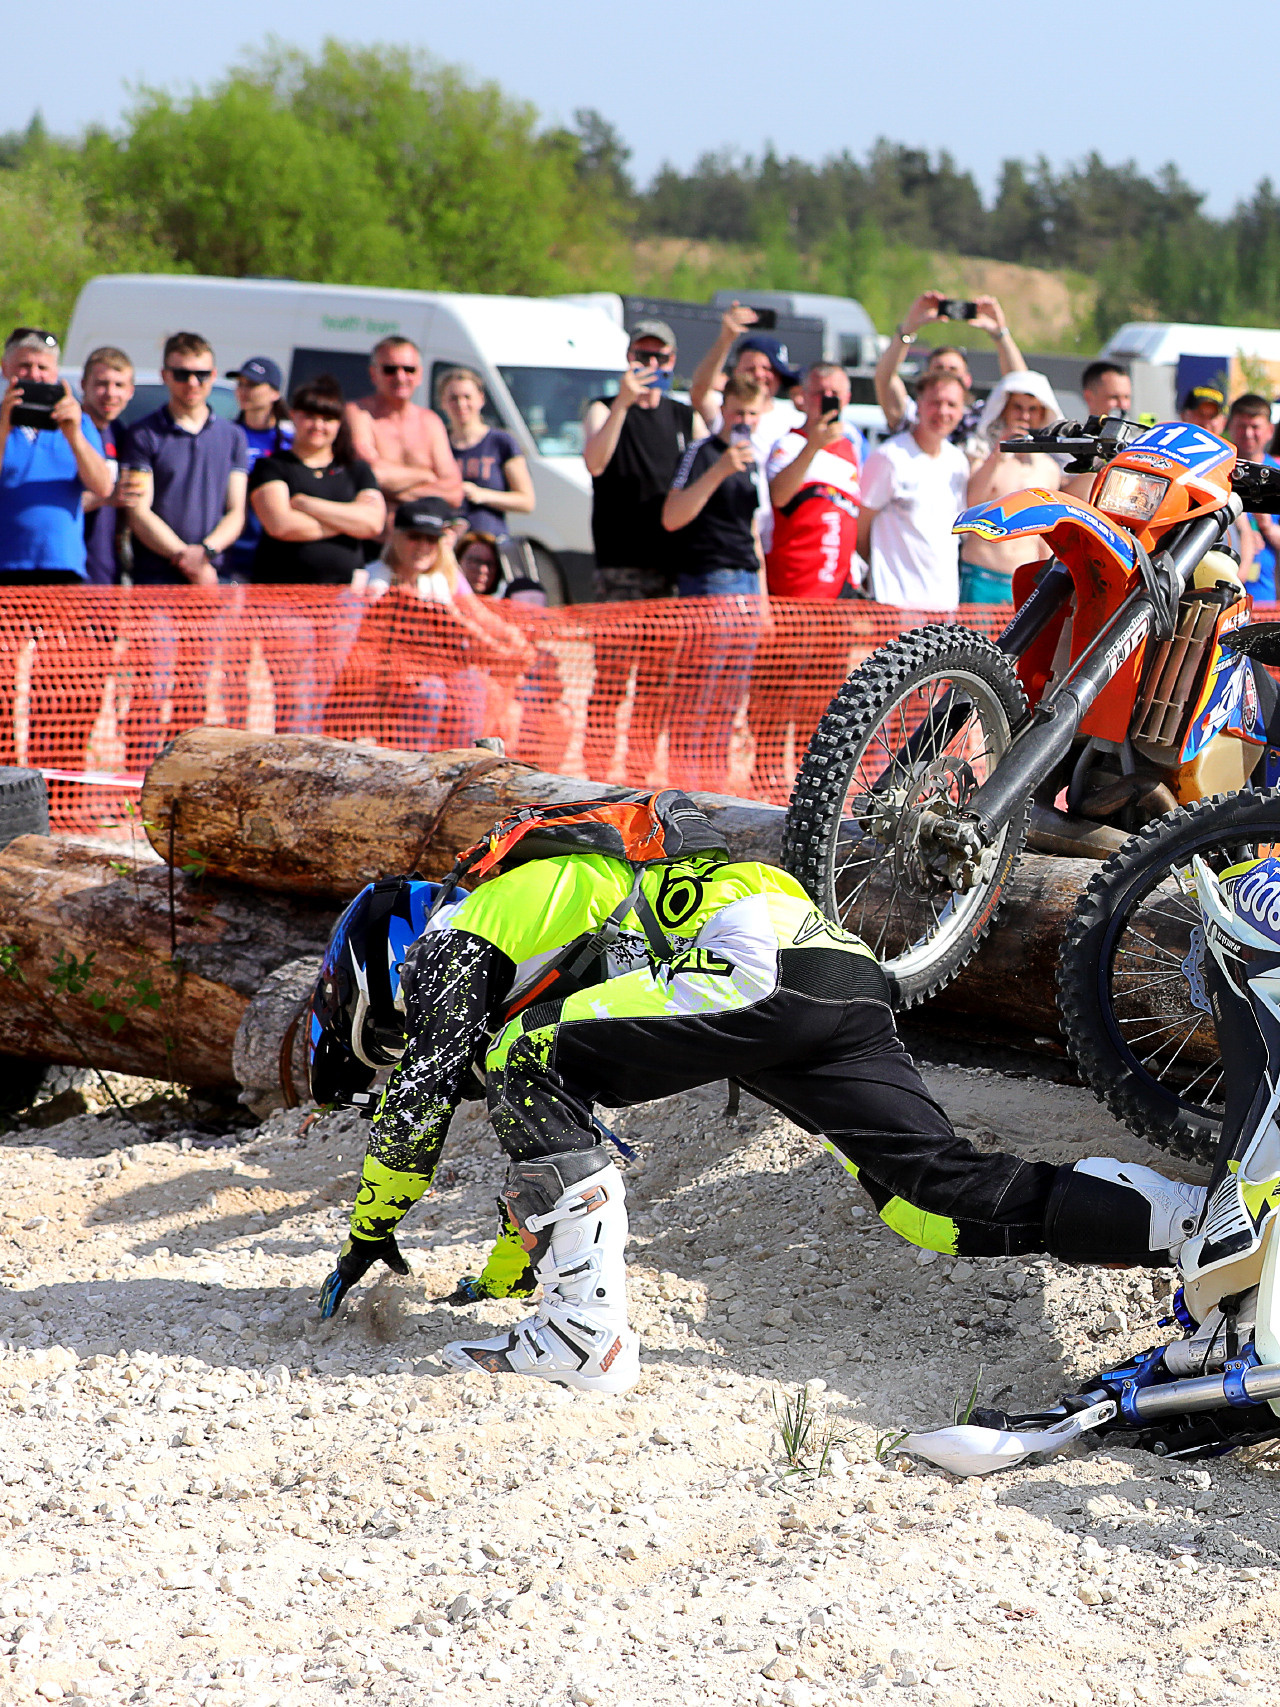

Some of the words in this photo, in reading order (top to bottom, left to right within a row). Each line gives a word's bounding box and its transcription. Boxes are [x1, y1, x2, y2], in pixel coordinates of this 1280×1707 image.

[1135, 426, 1222, 454] 117
[1105, 611, 1146, 660] suspension
[1000, 852, 1015, 885] KENDA
[599, 1335, 623, 1373] LEATT
